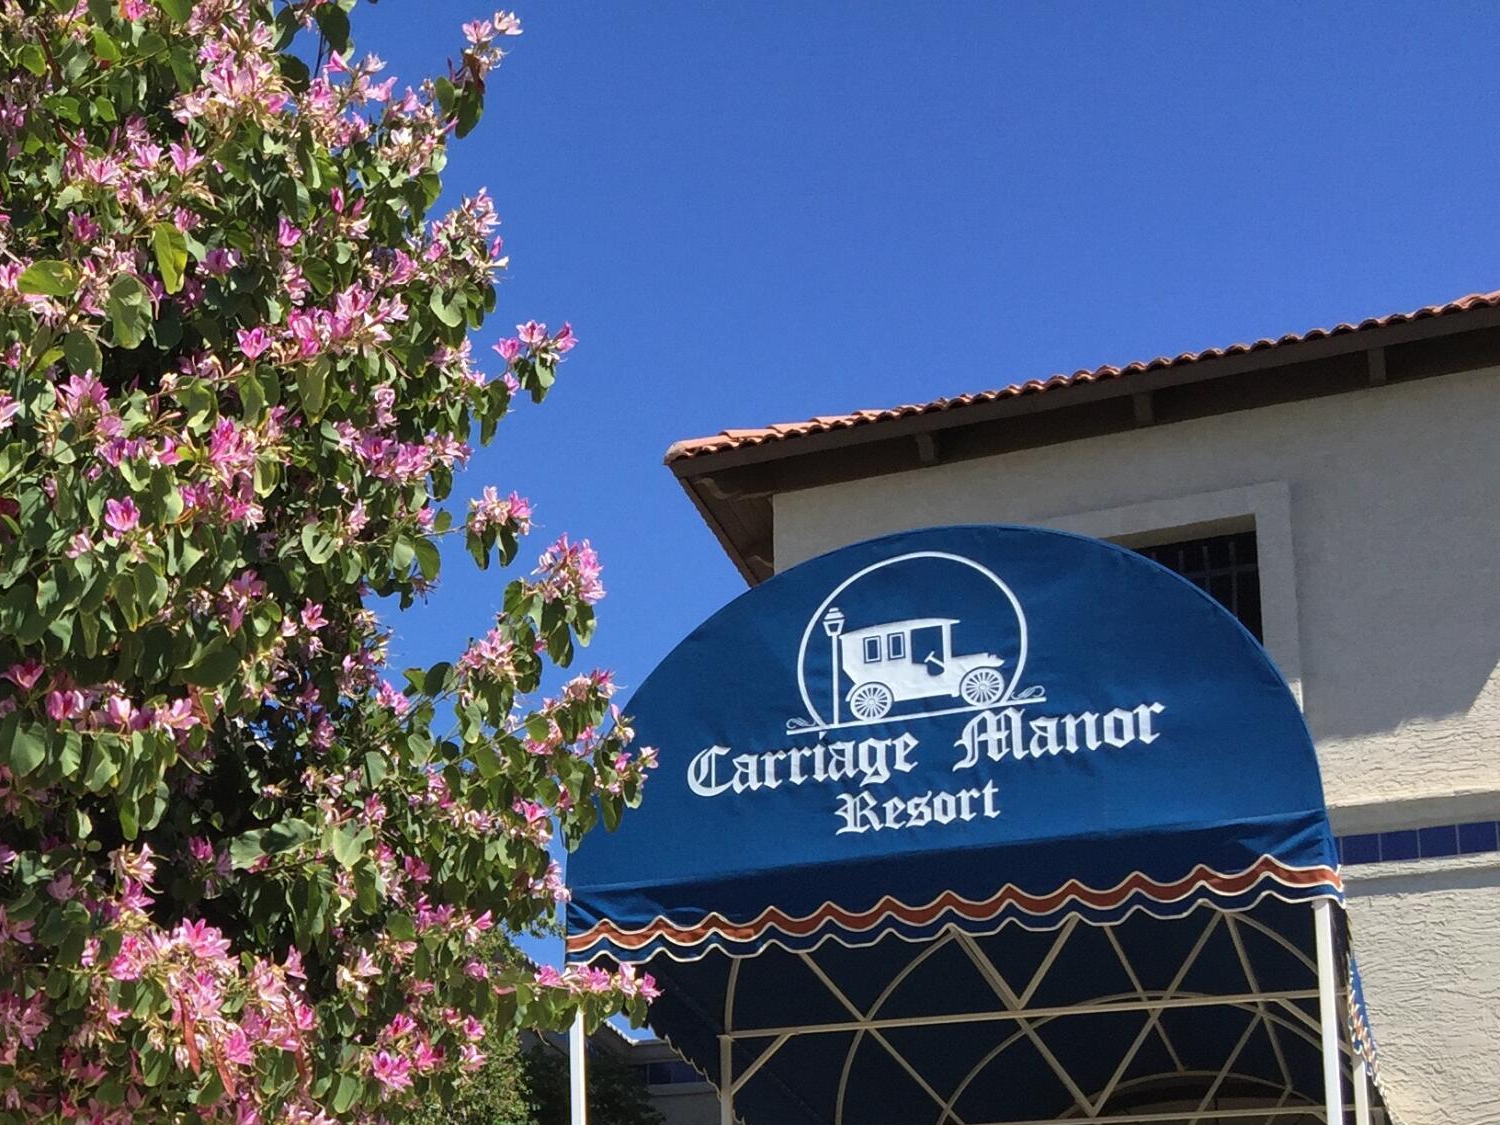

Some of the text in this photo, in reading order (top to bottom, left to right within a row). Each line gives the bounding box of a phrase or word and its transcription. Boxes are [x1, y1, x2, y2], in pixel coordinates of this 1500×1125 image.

[686, 701, 1165, 797] Carriage Manor
[835, 780, 1000, 835] Resort
